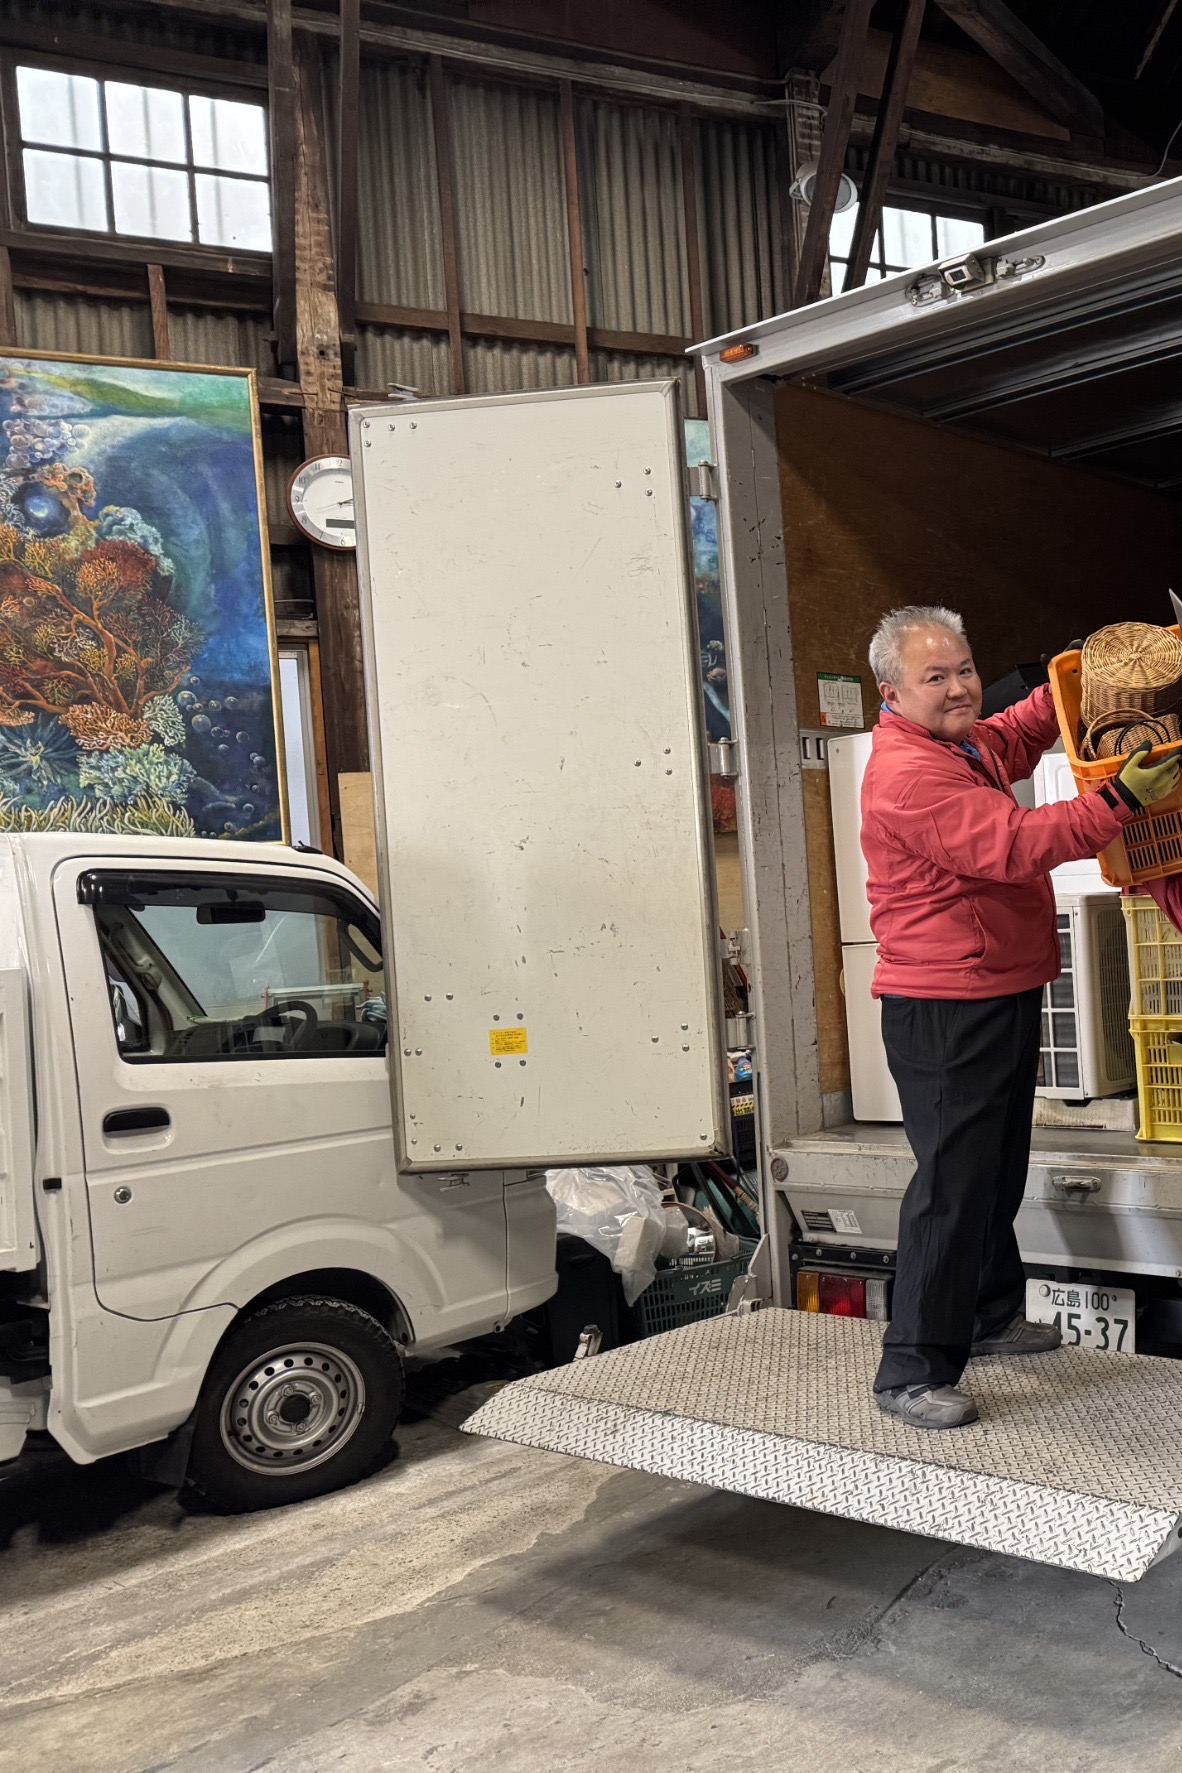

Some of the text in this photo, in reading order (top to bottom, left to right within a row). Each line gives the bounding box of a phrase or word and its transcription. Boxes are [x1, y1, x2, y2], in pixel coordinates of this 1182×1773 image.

[689, 1278, 722, 1296] イズミ
[1051, 1288, 1110, 1311] 広島 100
